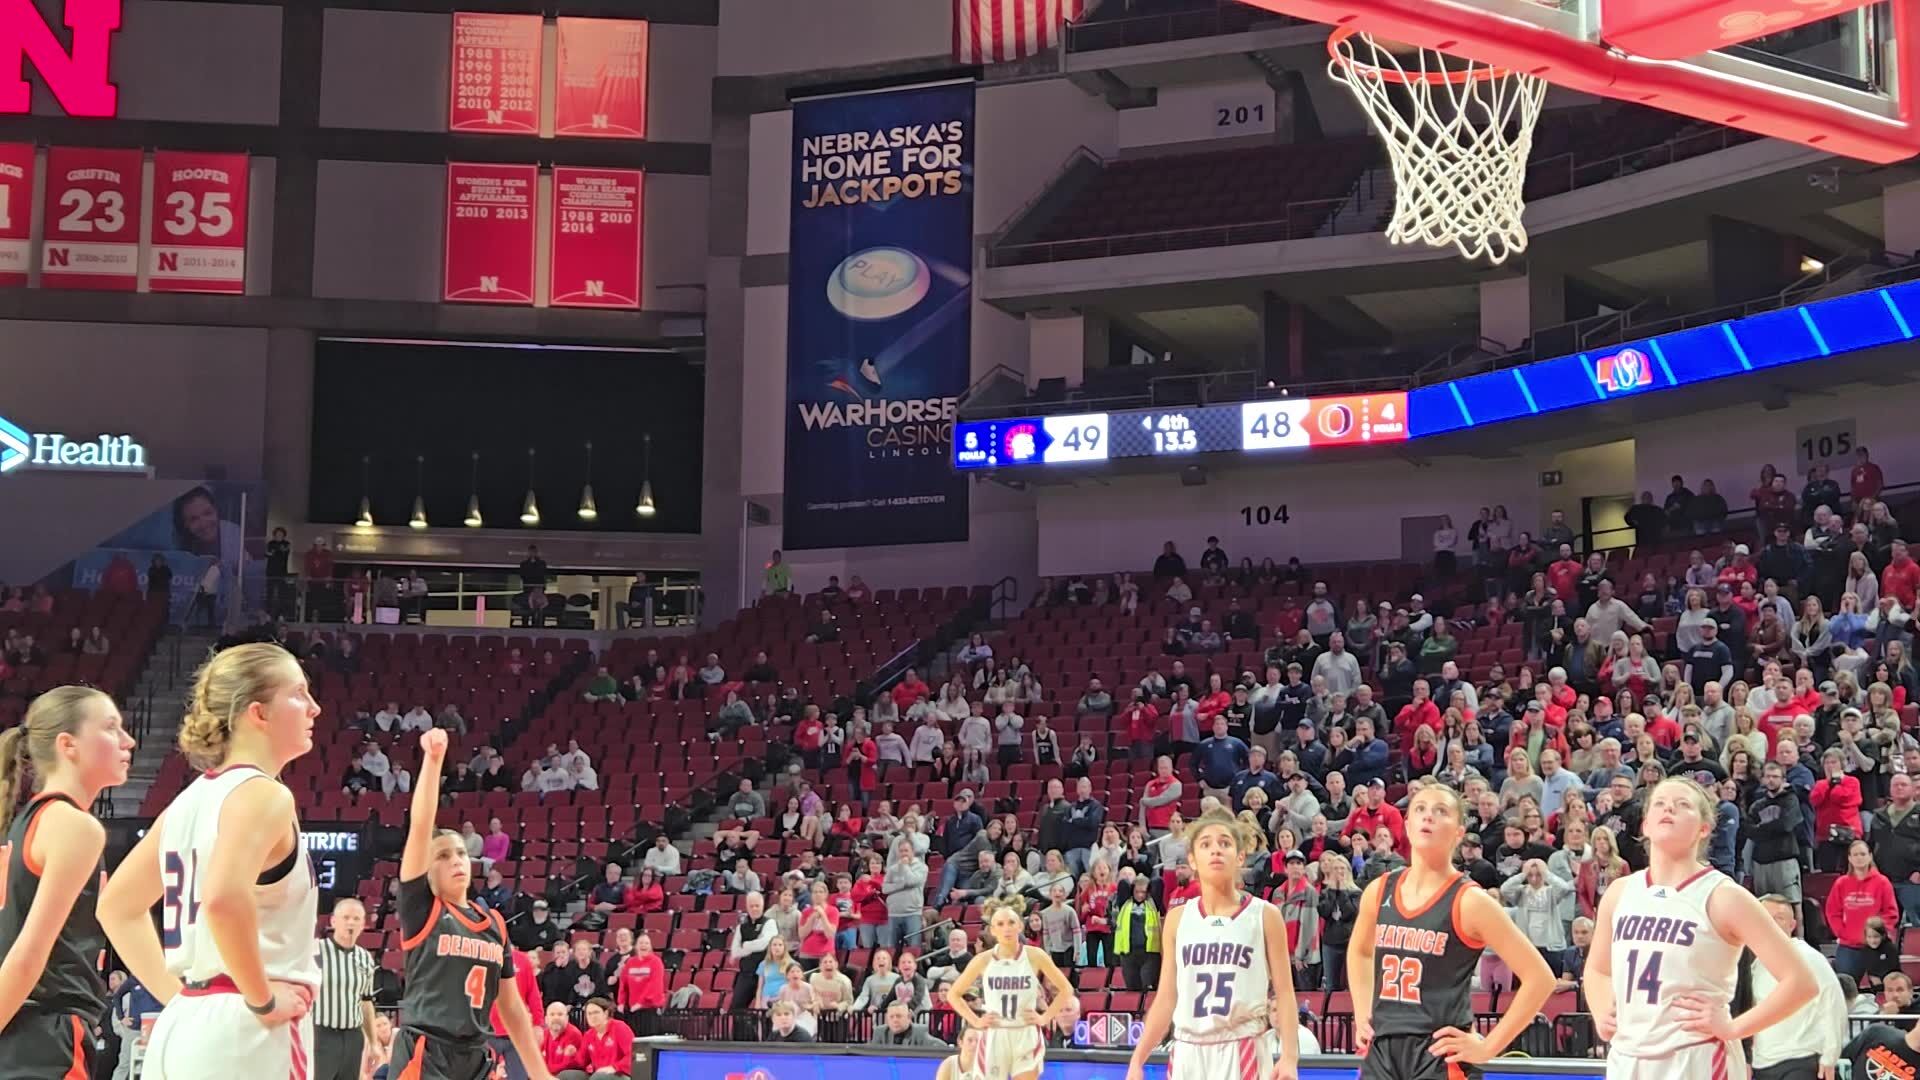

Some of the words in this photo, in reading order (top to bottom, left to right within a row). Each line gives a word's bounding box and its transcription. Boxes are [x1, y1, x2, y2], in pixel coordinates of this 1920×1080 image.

[460, 48, 493, 60] 1988
[459, 60, 492, 72] 1996
[459, 72, 492, 85] 1999
[458, 85, 492, 97] 2007
[458, 97, 491, 109] 2010
[500, 99, 532, 111] 2012
[486, 110, 504, 124] N
[1217, 104, 1264, 126] 201
[803, 121, 963, 157] NEBRASKA'S
[802, 151, 892, 182] HOME
[902, 144, 962, 171] FOR
[67, 168, 120, 184] GRIFFIN
[172, 168, 229, 184] HOOPER
[802, 170, 962, 208] JACKPOTS
[59, 188, 125, 232] 23
[163, 191, 233, 237] 35
[455, 206, 488, 218] 2010
[496, 208, 528, 219] 2013
[562, 210, 594, 222] 1988
[600, 212, 632, 224] 2010
[561, 222, 594, 233] 2014
[48, 248, 69, 266] N
[158, 252, 178, 271] N
[480, 277, 498, 292] N
[585, 280, 603, 297] N
[798, 397, 957, 431] WARHORSE
[1381, 402, 1396, 420] 4
[1158, 414, 1189, 430] 4th
[1250, 411, 1291, 438] 48
[966, 432, 978, 448] 5
[1063, 425, 1100, 451] 49
[1154, 430, 1197, 451] 13.5
[1801, 430, 1851, 461] 105
[32, 433, 145, 466] Health
[869, 447, 942, 459] LINCOL
[1241, 504, 1290, 526] 104
[299, 831, 358, 850] ATRICE
[1375, 924, 1449, 956] EATRICE
[1613, 915, 1698, 947] NORRIS
[437, 933, 504, 968] BEATRIC
[1182, 942, 1254, 969] NORRIS
[464, 965, 487, 1009] 4
[988, 975, 1032, 991] NORRIS
[1379, 954, 1423, 1004] 22
[1626, 949, 1663, 1005] 14
[1193, 972, 1236, 1018] 25
[1001, 994, 1018, 1020] 11
